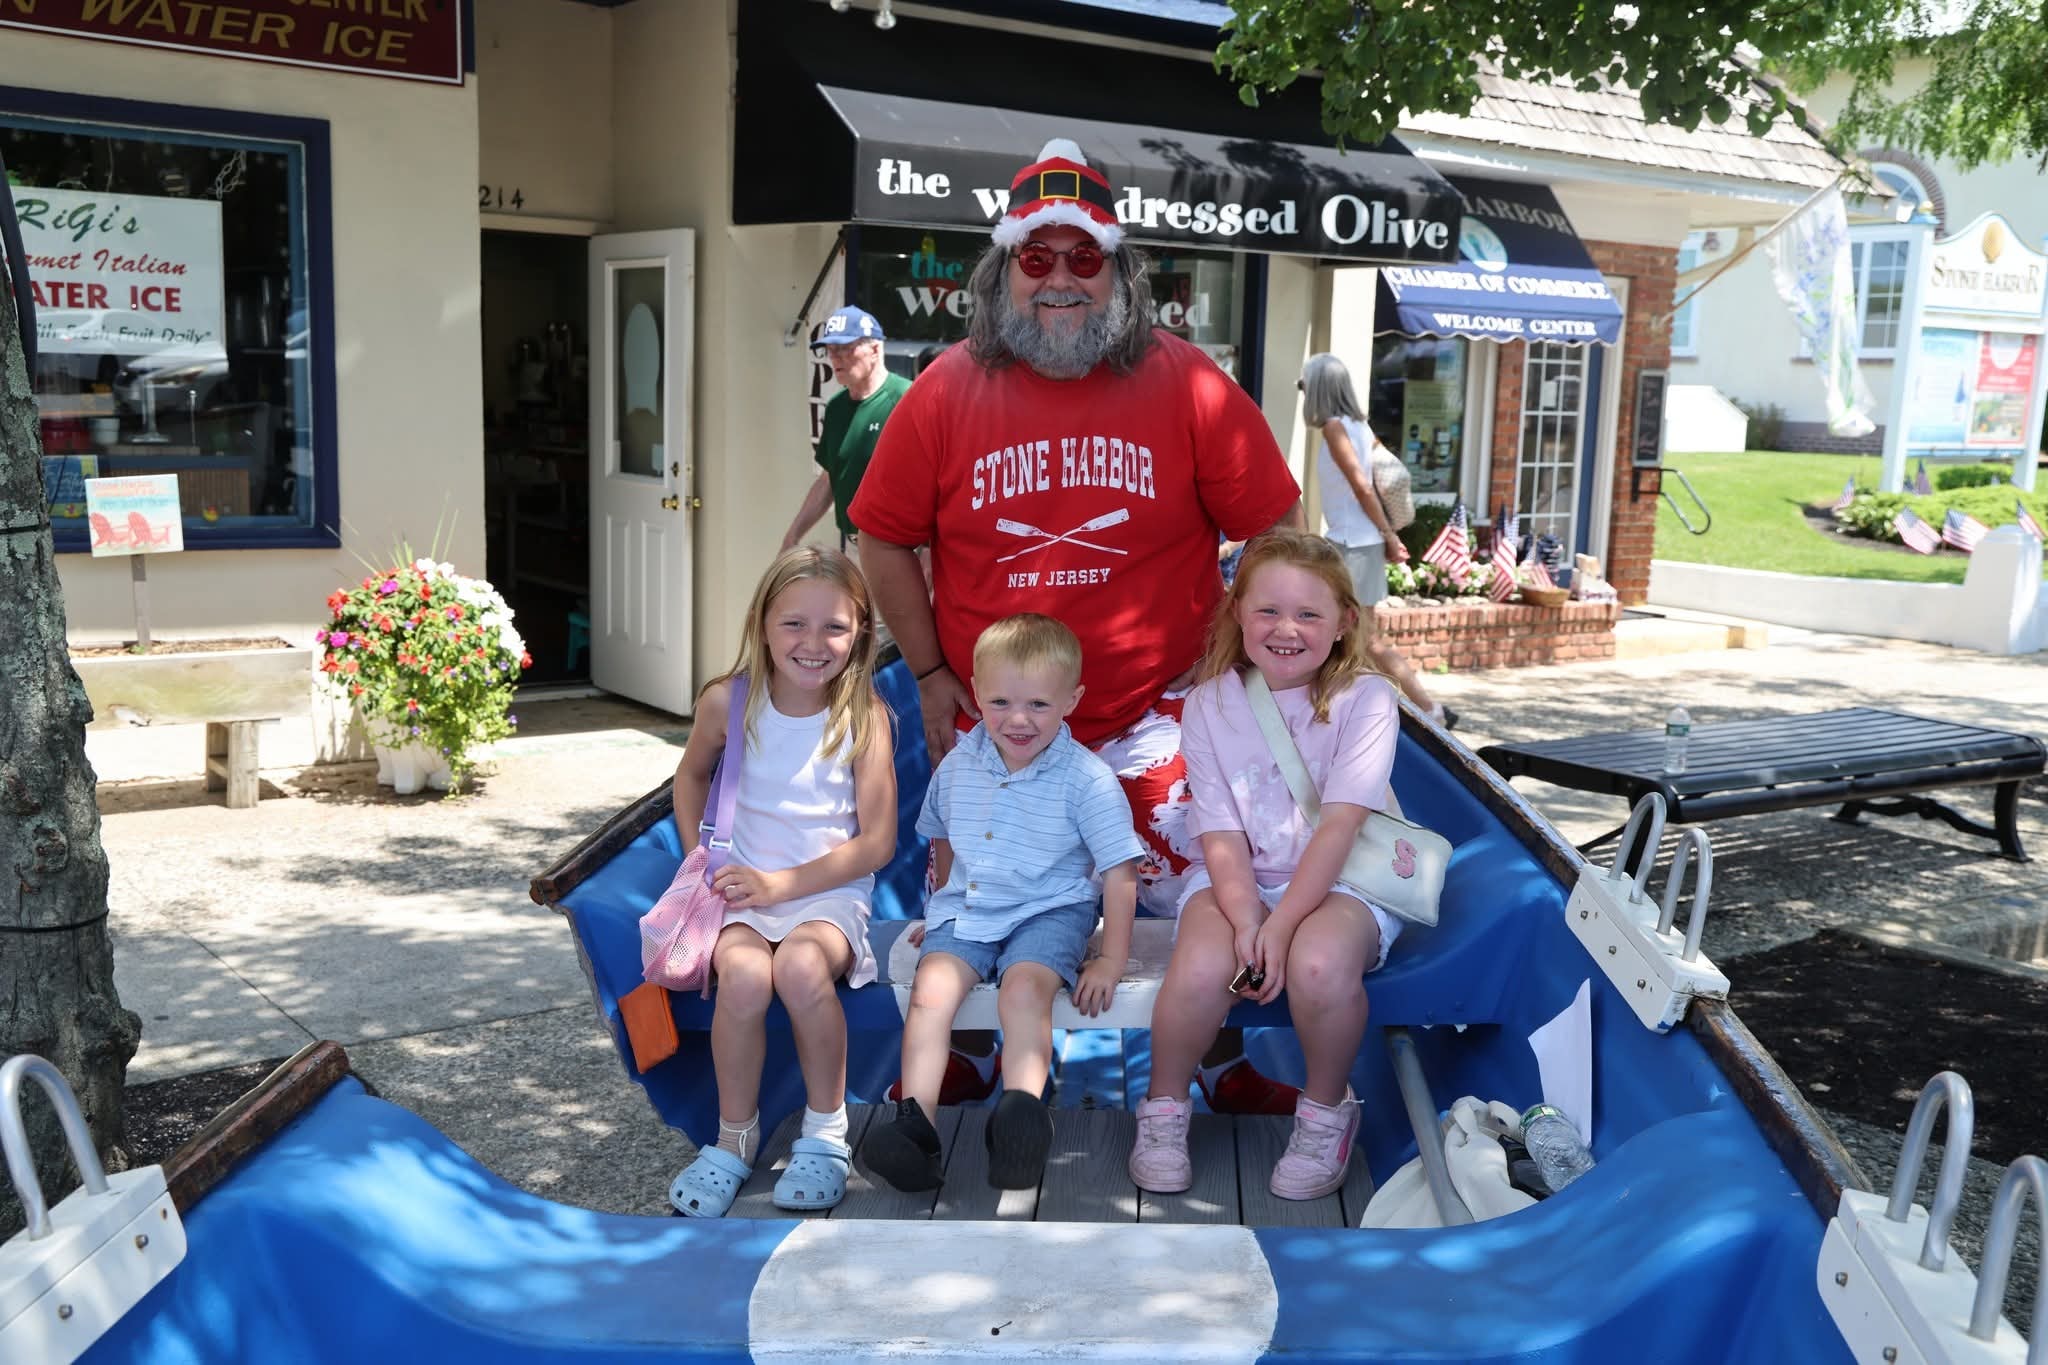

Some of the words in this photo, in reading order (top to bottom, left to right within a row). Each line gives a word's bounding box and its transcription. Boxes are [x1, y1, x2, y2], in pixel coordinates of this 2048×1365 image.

[80, 0, 295, 48] WATER
[322, 22, 414, 63] ICE
[876, 158, 951, 197] the
[478, 185, 524, 209] 214
[1113, 186, 1299, 236] dressed
[1321, 194, 1449, 249] Olive
[93, 248, 188, 275] Italian
[911, 251, 963, 281] the
[30, 280, 110, 309] ATER
[129, 285, 182, 313] ICE
[1387, 266, 1480, 293] CHAMBER
[1480, 272, 1506, 293] OF
[1507, 275, 1612, 299] COMMERCE
[1432, 312, 1524, 334] WELCOME
[1530, 318, 1597, 337] CENTER
[971, 439, 1050, 511] STONE
[1060, 435, 1156, 500] HARBOR
[1007, 571, 1041, 588] NEW
[1045, 567, 1111, 586] JERSEY
